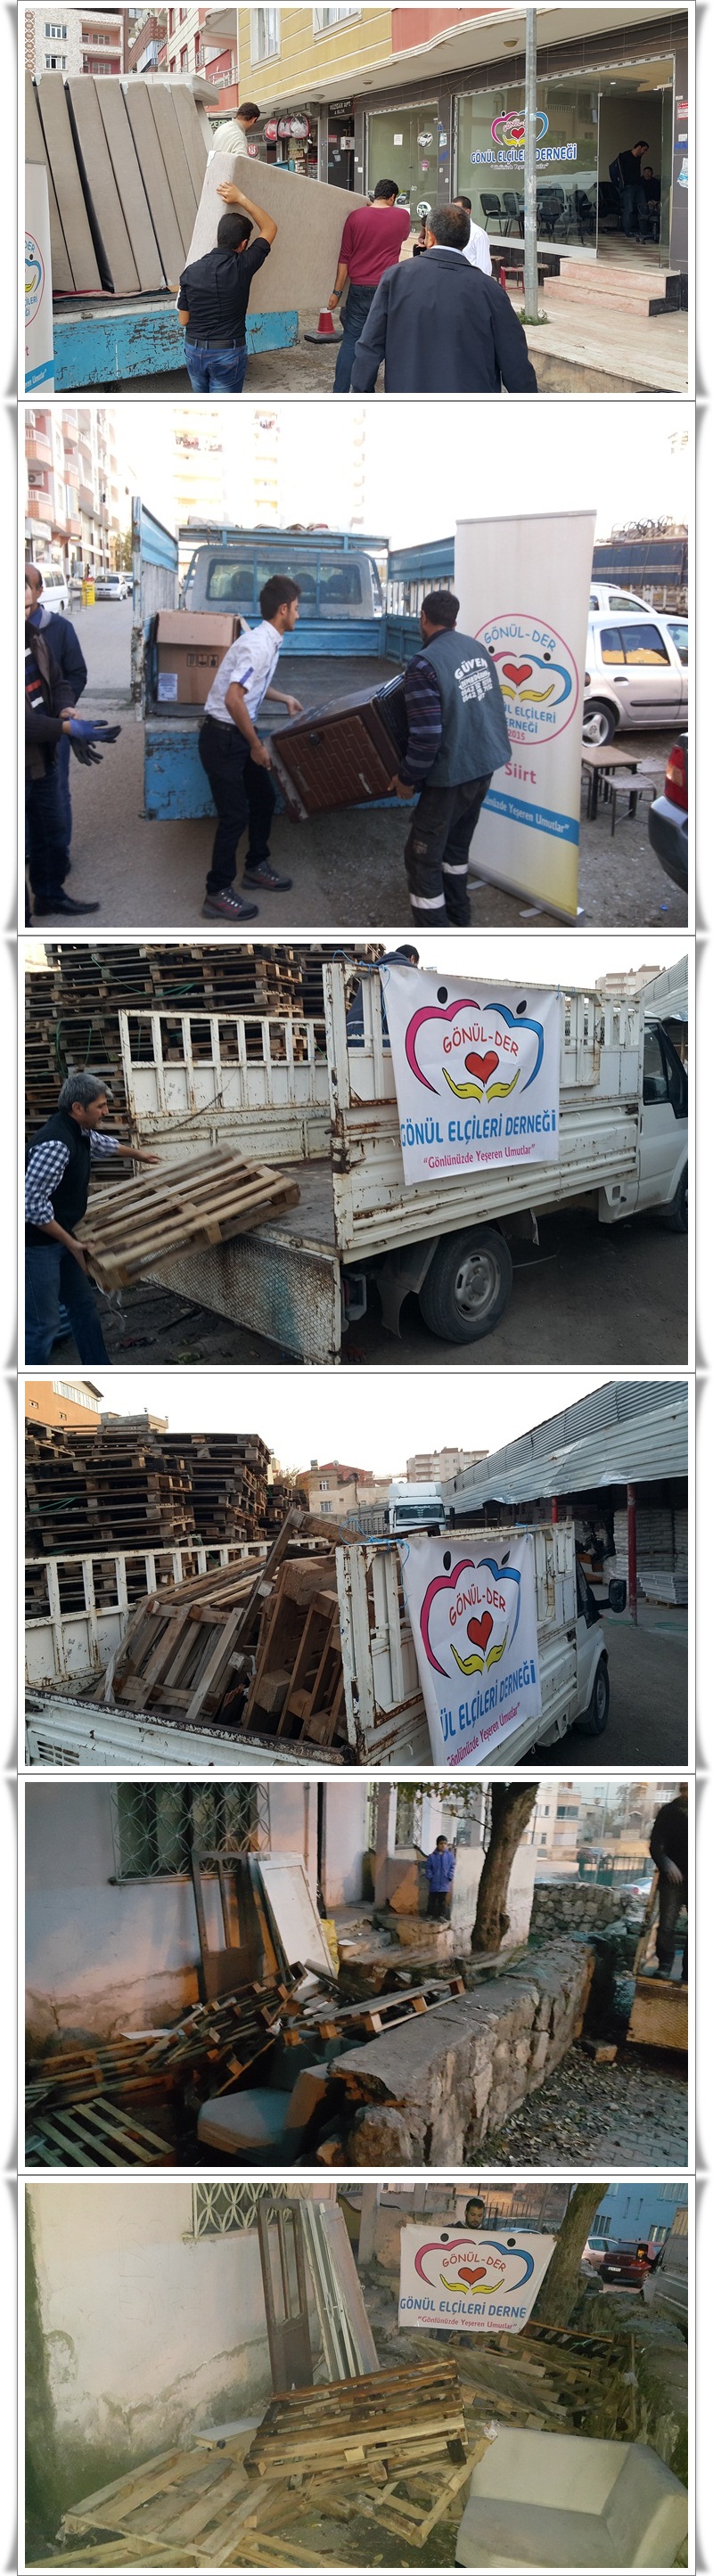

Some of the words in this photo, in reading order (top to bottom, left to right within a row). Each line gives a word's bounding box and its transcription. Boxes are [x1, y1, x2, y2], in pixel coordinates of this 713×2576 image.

[471, 149, 496, 163] GÖNÜL
[497, 147, 525, 165] ELÇİLE
[484, 624, 556, 651] GÖNÜL-DER
[455, 658, 488, 680] GÜVEN
[514, 706, 556, 724] ELÇİLERİ
[508, 730, 526, 740] 2015
[504, 761, 537, 784] Siirt
[509, 804, 534, 822] Yeşeren
[442, 1023, 519, 1058] GÖNÜL-DER
[448, 1114, 502, 1145] ELÇİLERİ
[504, 1109, 556, 1136] DERNEĞİ
[476, 1148, 503, 1163] Yeşeren
[449, 1583, 506, 1626] GÖNÜL-DER
[458, 1679, 497, 1729] ELÇİLERİ
[500, 1659, 537, 1703] DERNEĞİ
[479, 1720, 499, 1743] Yeşeren
[442, 2251, 507, 2273] GÖNÜL-DER
[399, 2295, 436, 2311] GÖNÜL
[438, 2300, 486, 2317] ELÇİLERİ
[488, 2305, 527, 2318] DERNE
[461, 2319, 485, 2328] Yeşeren
